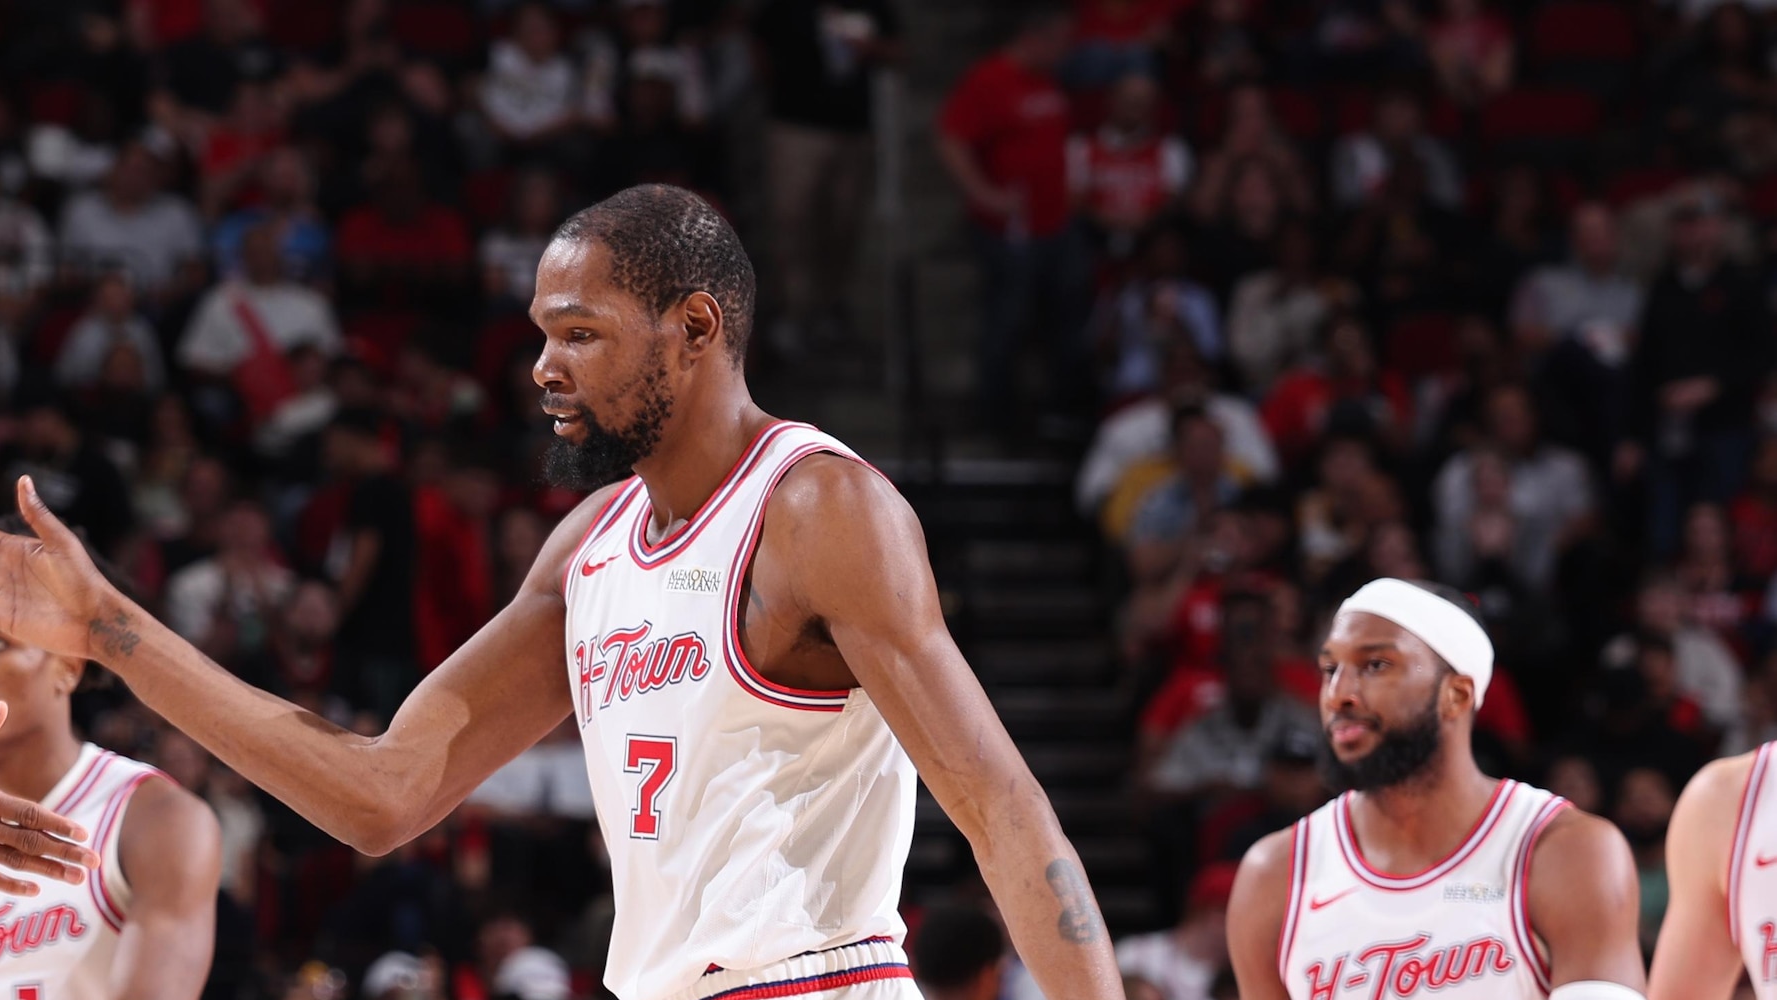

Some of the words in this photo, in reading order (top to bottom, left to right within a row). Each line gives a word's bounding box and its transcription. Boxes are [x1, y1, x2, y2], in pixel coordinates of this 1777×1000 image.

[666, 579, 721, 592] HERMANN
[670, 568, 722, 583] MEMORIAL
[574, 619, 712, 729] H-Town
[623, 733, 678, 841] 7
